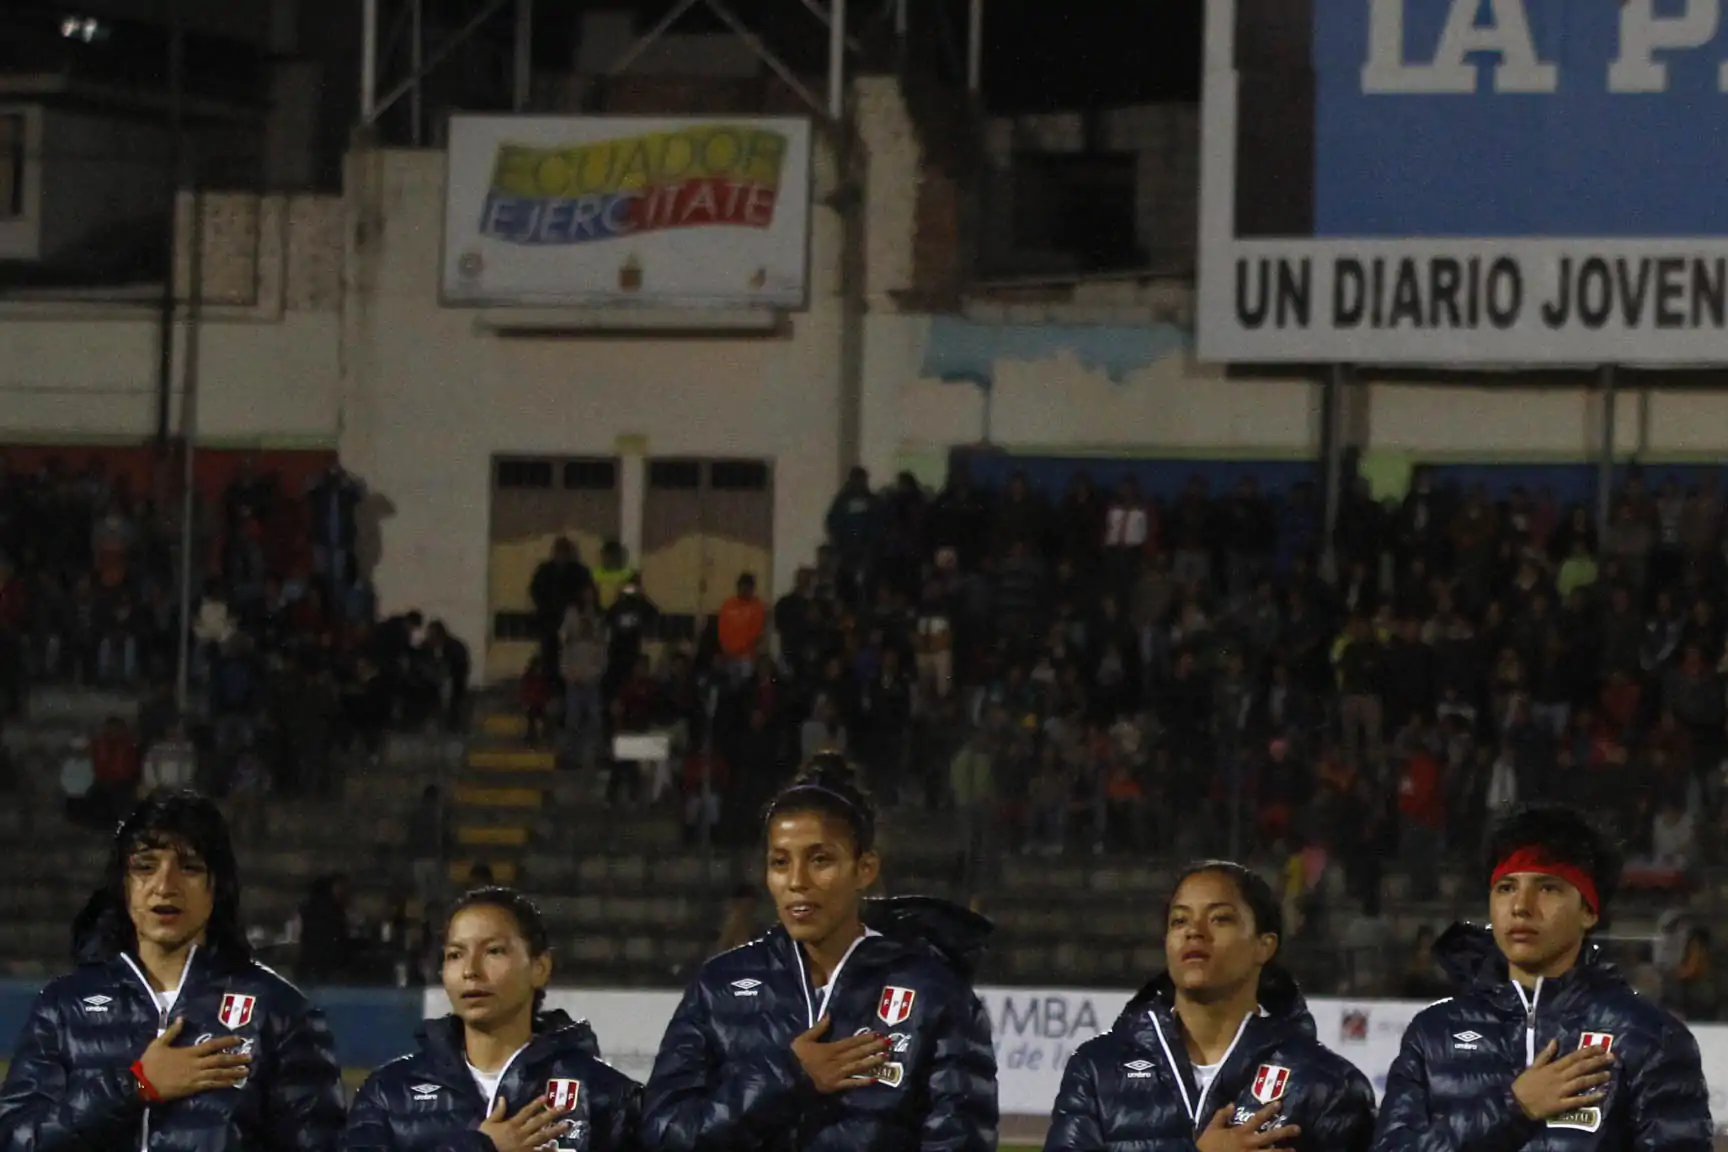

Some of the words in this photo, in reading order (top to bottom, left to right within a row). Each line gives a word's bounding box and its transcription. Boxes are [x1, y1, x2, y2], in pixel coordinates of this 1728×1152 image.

[1360, 0, 1556, 93] LA
[1234, 256, 1311, 330] UN
[1332, 256, 1523, 330] DIARIO
[1540, 256, 1728, 330] JOVEN
